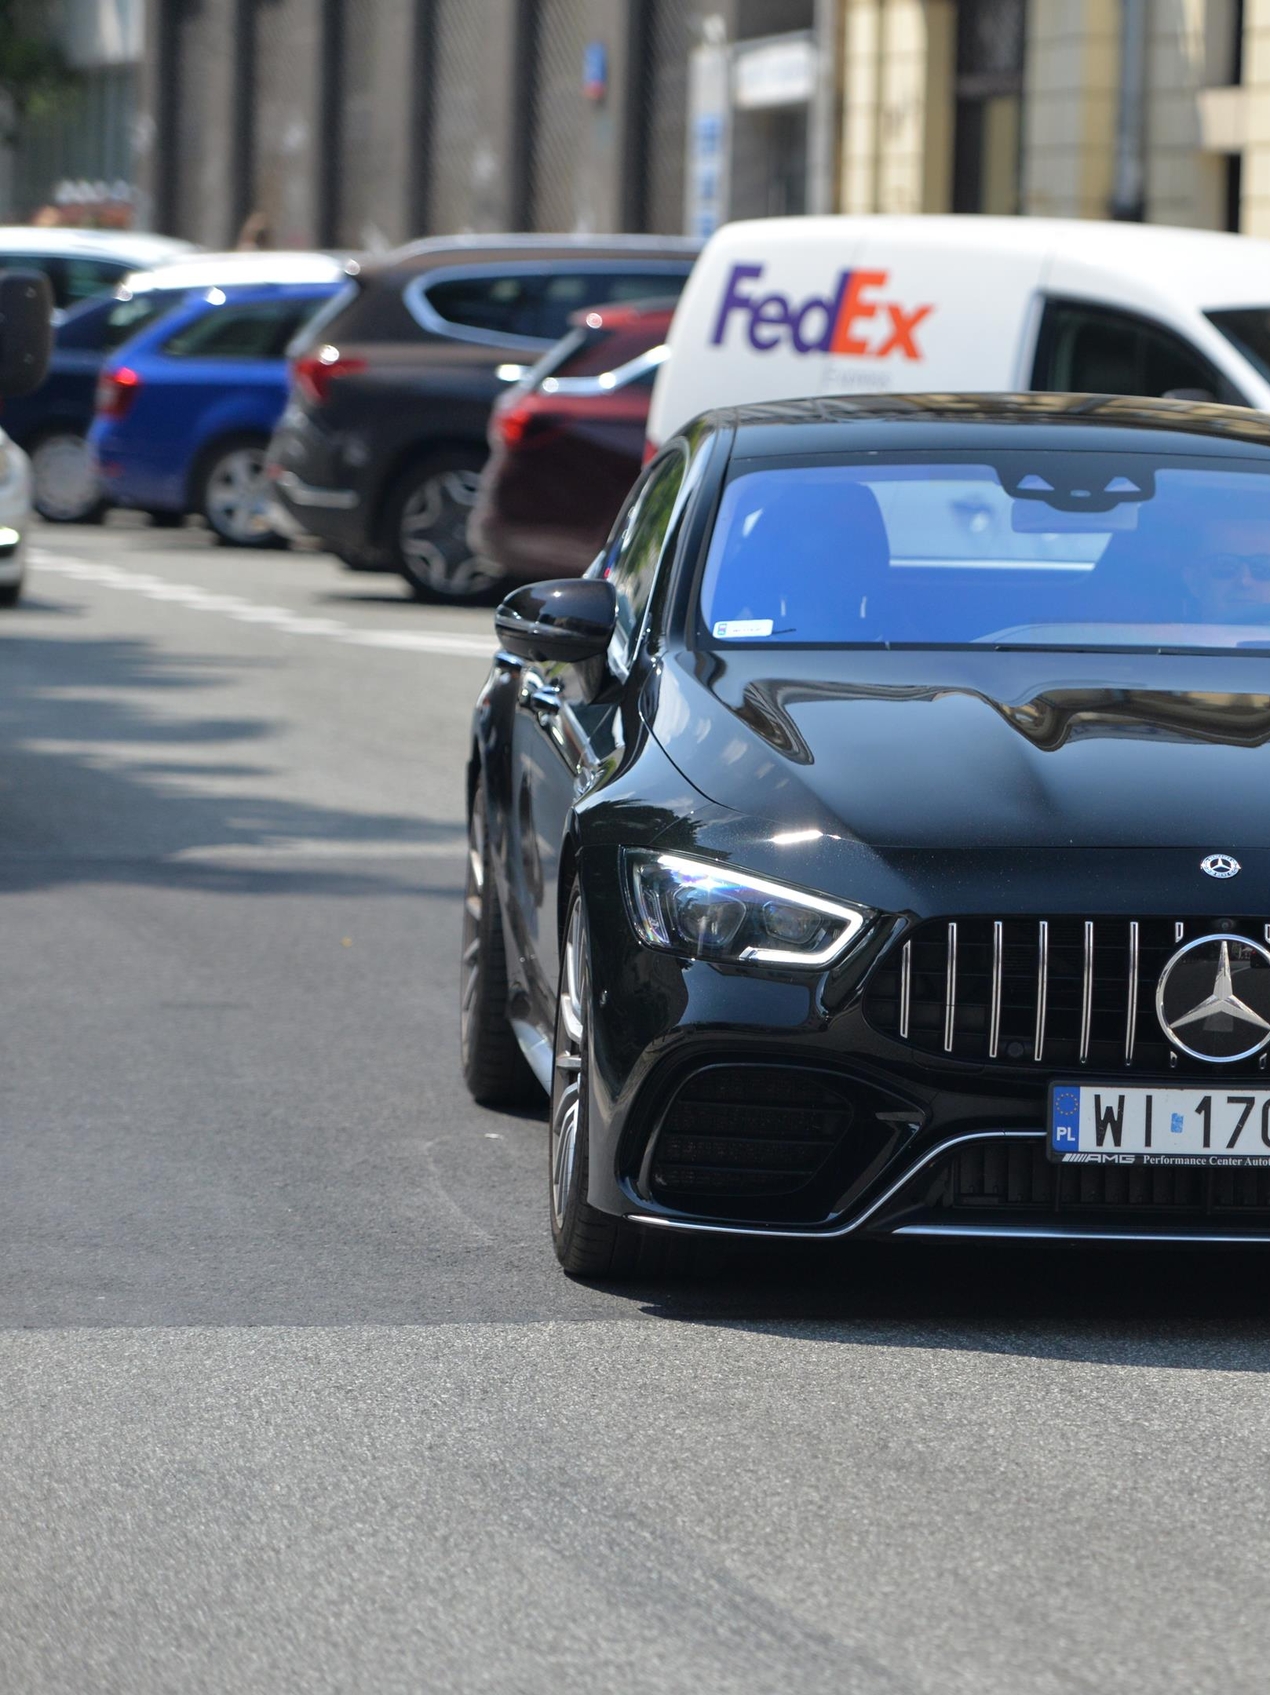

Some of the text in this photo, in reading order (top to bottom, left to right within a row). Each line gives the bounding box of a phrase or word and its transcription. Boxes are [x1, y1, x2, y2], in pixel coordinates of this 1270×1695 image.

[711, 264, 933, 360] FedEx
[1056, 1126, 1076, 1142] PL
[1094, 1094, 1153, 1148] WI
[1143, 1155, 1207, 1165] Performance
[1209, 1156, 1243, 1166] Center
